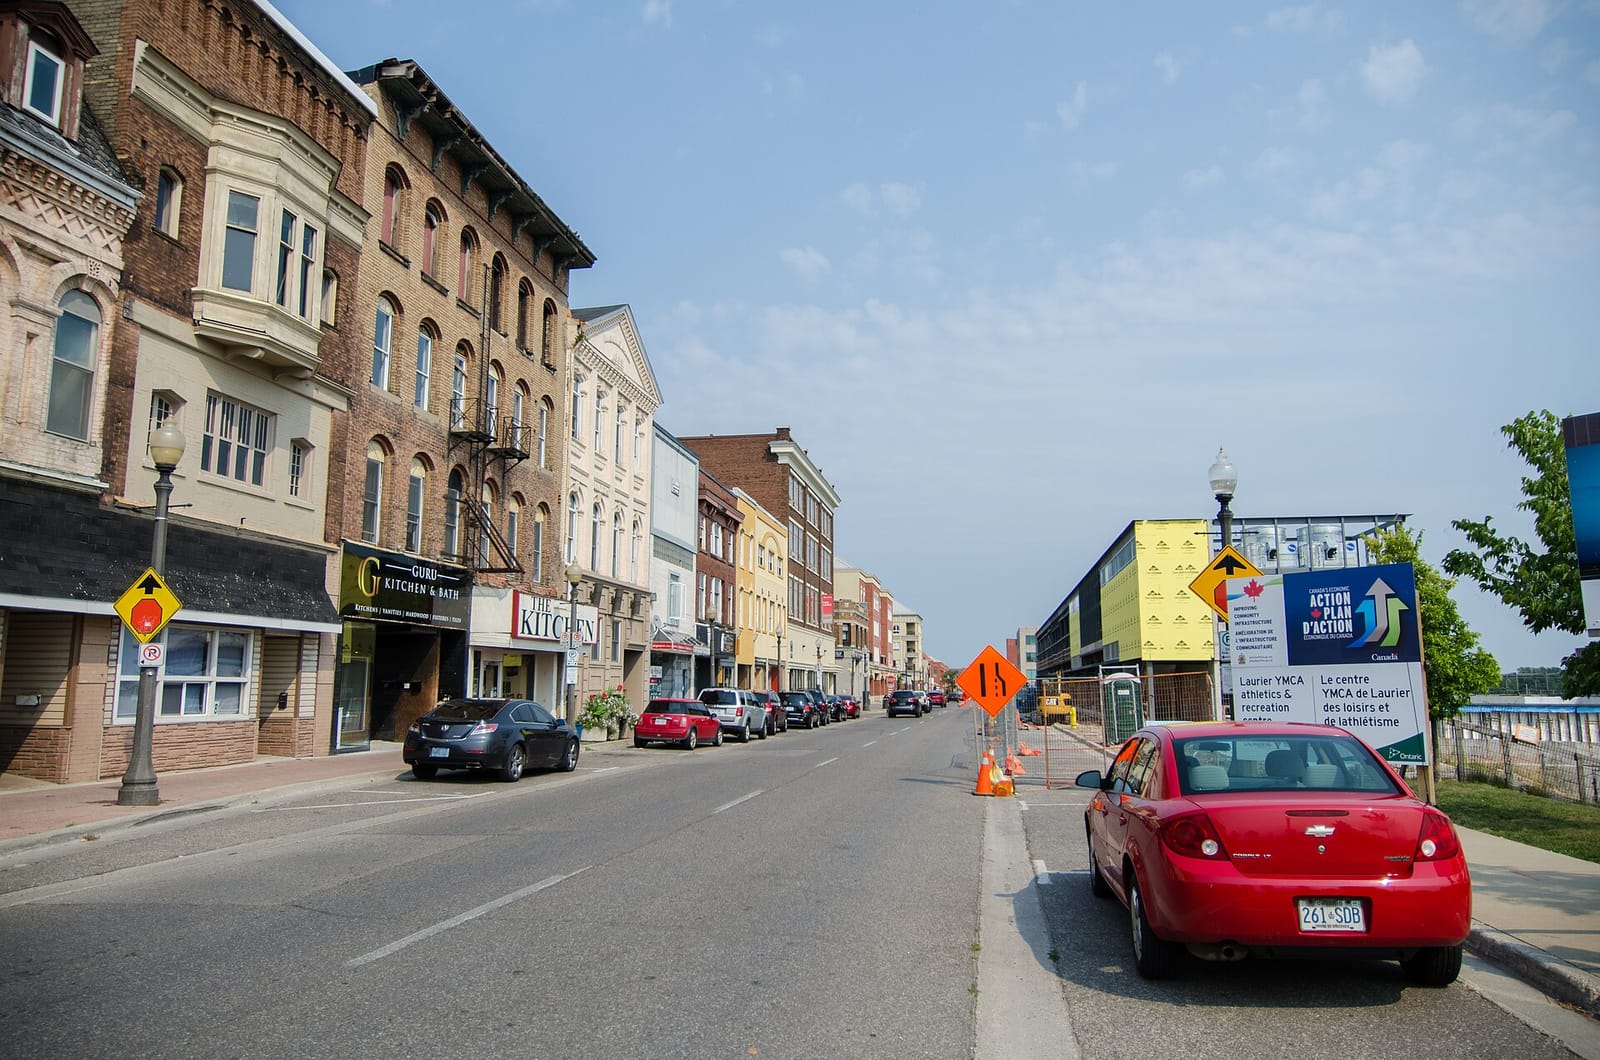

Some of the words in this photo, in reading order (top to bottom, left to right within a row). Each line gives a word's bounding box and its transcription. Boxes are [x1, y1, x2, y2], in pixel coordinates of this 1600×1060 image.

[412, 565, 437, 580] GURU
[384, 578, 426, 594] KITCHEN
[429, 586, 436, 596] &
[439, 587, 459, 600] BATH
[531, 596, 551, 613] THE
[1310, 592, 1351, 608] ACTION
[1323, 605, 1352, 620] PLAN
[1303, 619, 1353, 635] D'ACTION
[1371, 653, 1399, 661] Canada
[1239, 676, 1272, 686] Laurier
[1274, 675, 1305, 686] YMCA
[1320, 675, 1333, 685] Le
[1335, 674, 1370, 685] centre
[1241, 689, 1282, 699] athletics
[1284, 689, 1292, 699] &
[1321, 688, 1354, 699] YMCA
[1355, 688, 1369, 698] de
[1370, 687, 1411, 699] Laurier
[1241, 702, 1290, 712] recreation
[1323, 702, 1341, 713] des
[1343, 702, 1376, 713] loisirs
[1378, 702, 1390, 713] et
[1324, 716, 1336, 727] de
[1338, 716, 1400, 727] lathlétisme
[1302, 906, 1327, 924] 261
[1334, 906, 1361, 924] SDB
